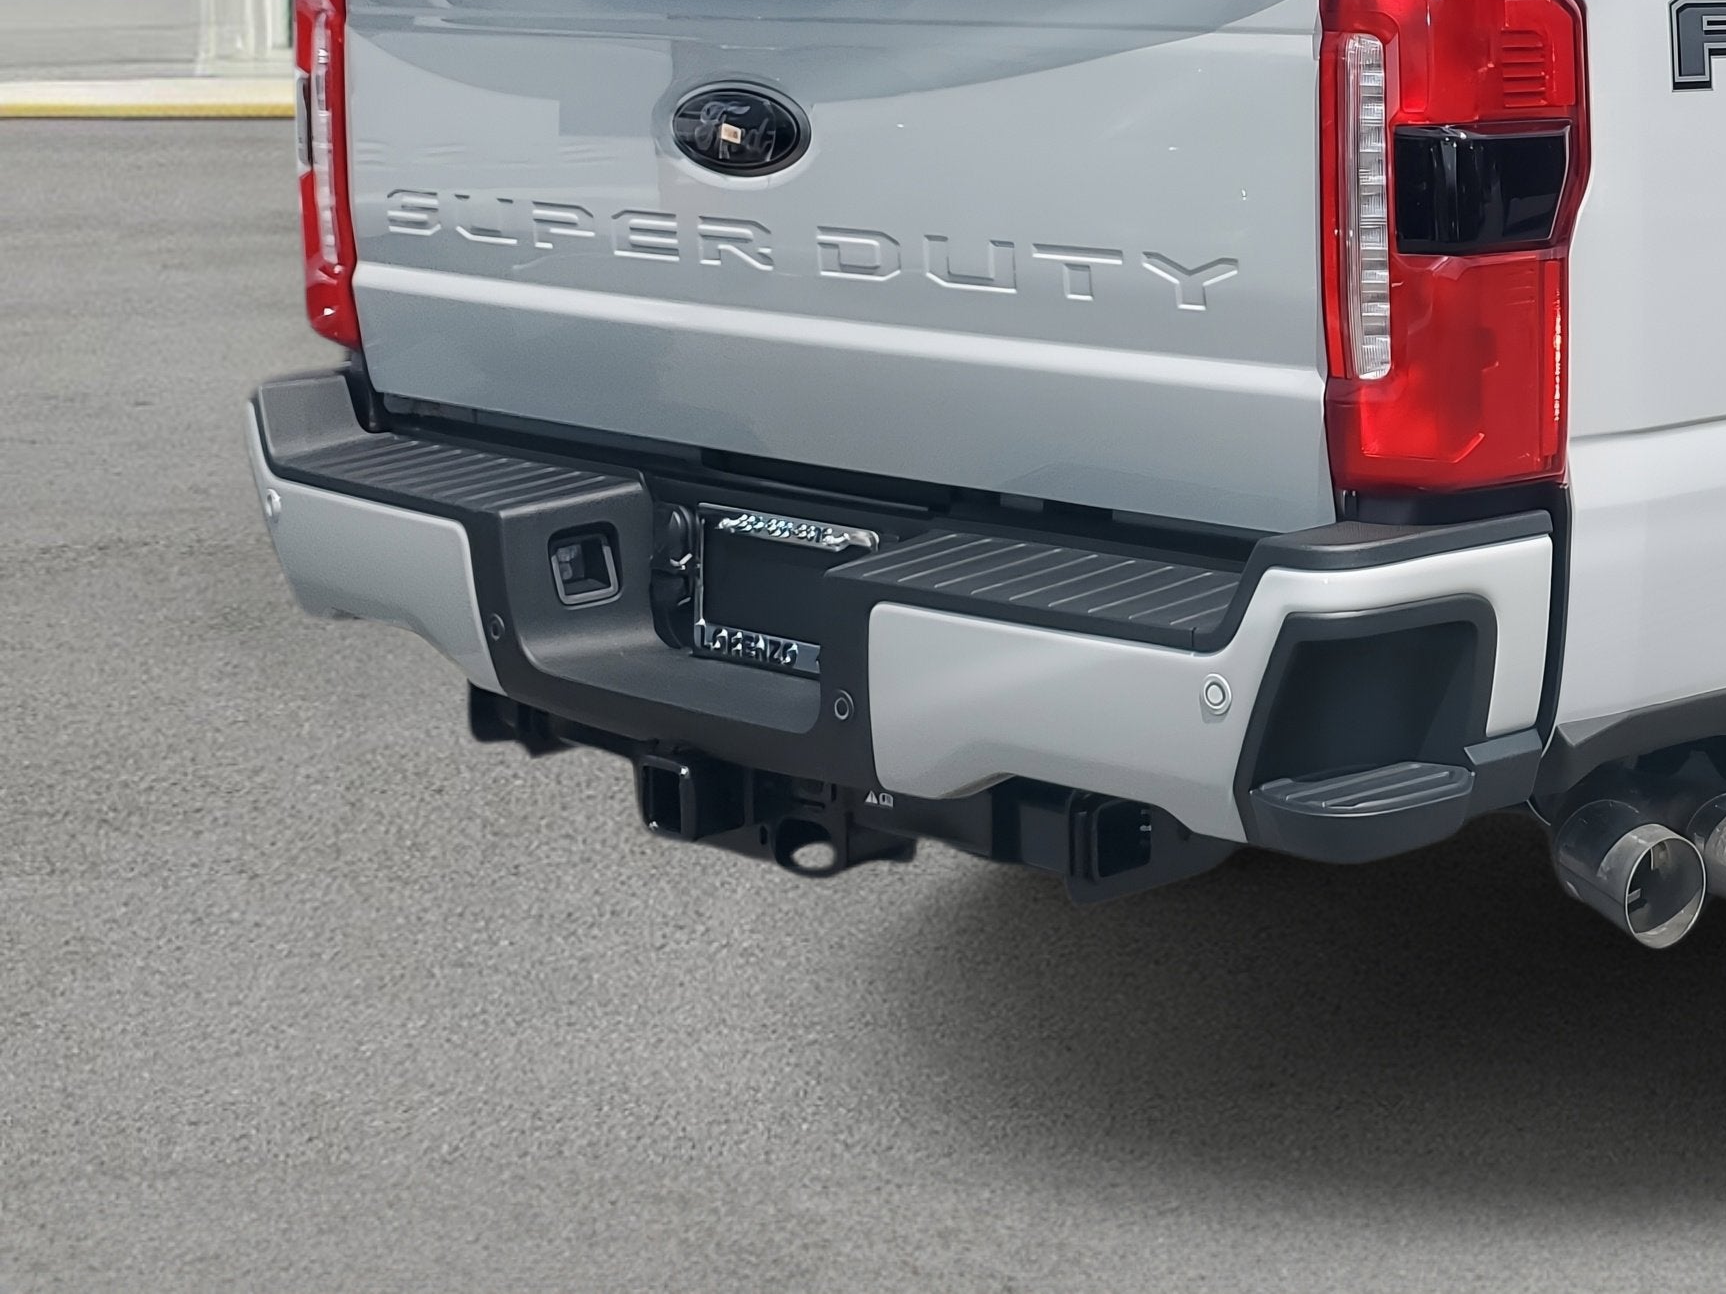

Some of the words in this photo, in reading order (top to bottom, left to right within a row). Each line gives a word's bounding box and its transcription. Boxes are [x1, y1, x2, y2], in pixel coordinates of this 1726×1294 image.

[386, 188, 776, 272] SUPER
[816, 225, 1240, 311] DUTY
[699, 622, 798, 667] LORENZO
